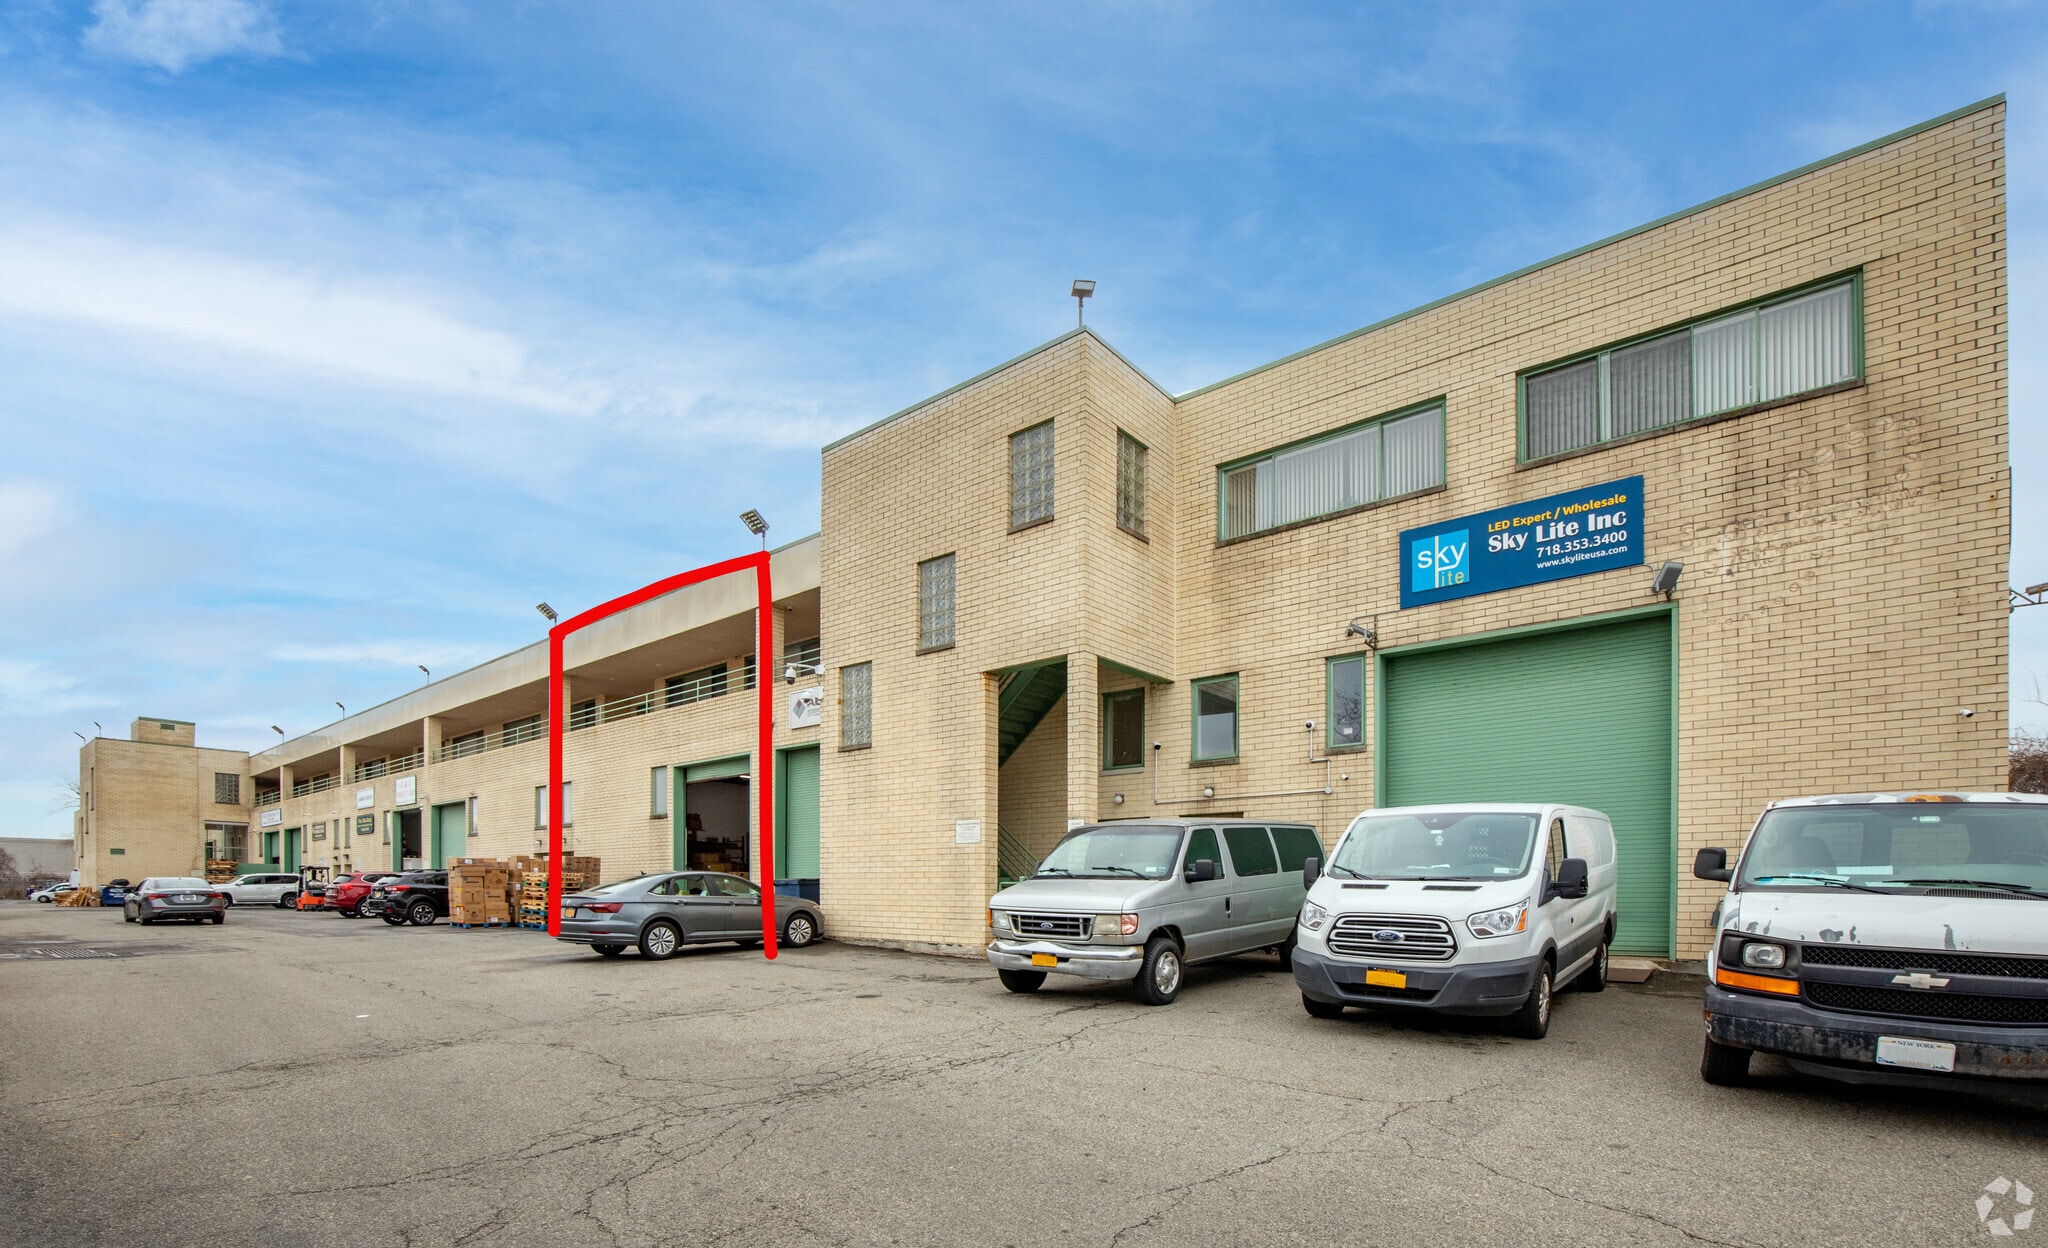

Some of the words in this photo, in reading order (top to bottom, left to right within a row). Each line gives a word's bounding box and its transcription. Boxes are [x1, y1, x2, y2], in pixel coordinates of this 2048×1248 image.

[1488, 519, 1511, 533] LED
[1513, 510, 1552, 528] Expert
[1553, 507, 1561, 520] /
[1563, 494, 1627, 516] Wholesale
[1488, 531, 1529, 553] Sky
[1535, 520, 1580, 543] Lite
[1587, 511, 1627, 532] Inc
[1536, 530, 1628, 558] 718.353.3400
[1536, 545, 1628, 569] www.skyliteusa.com
[1915, 1042, 1936, 1050] YORK
